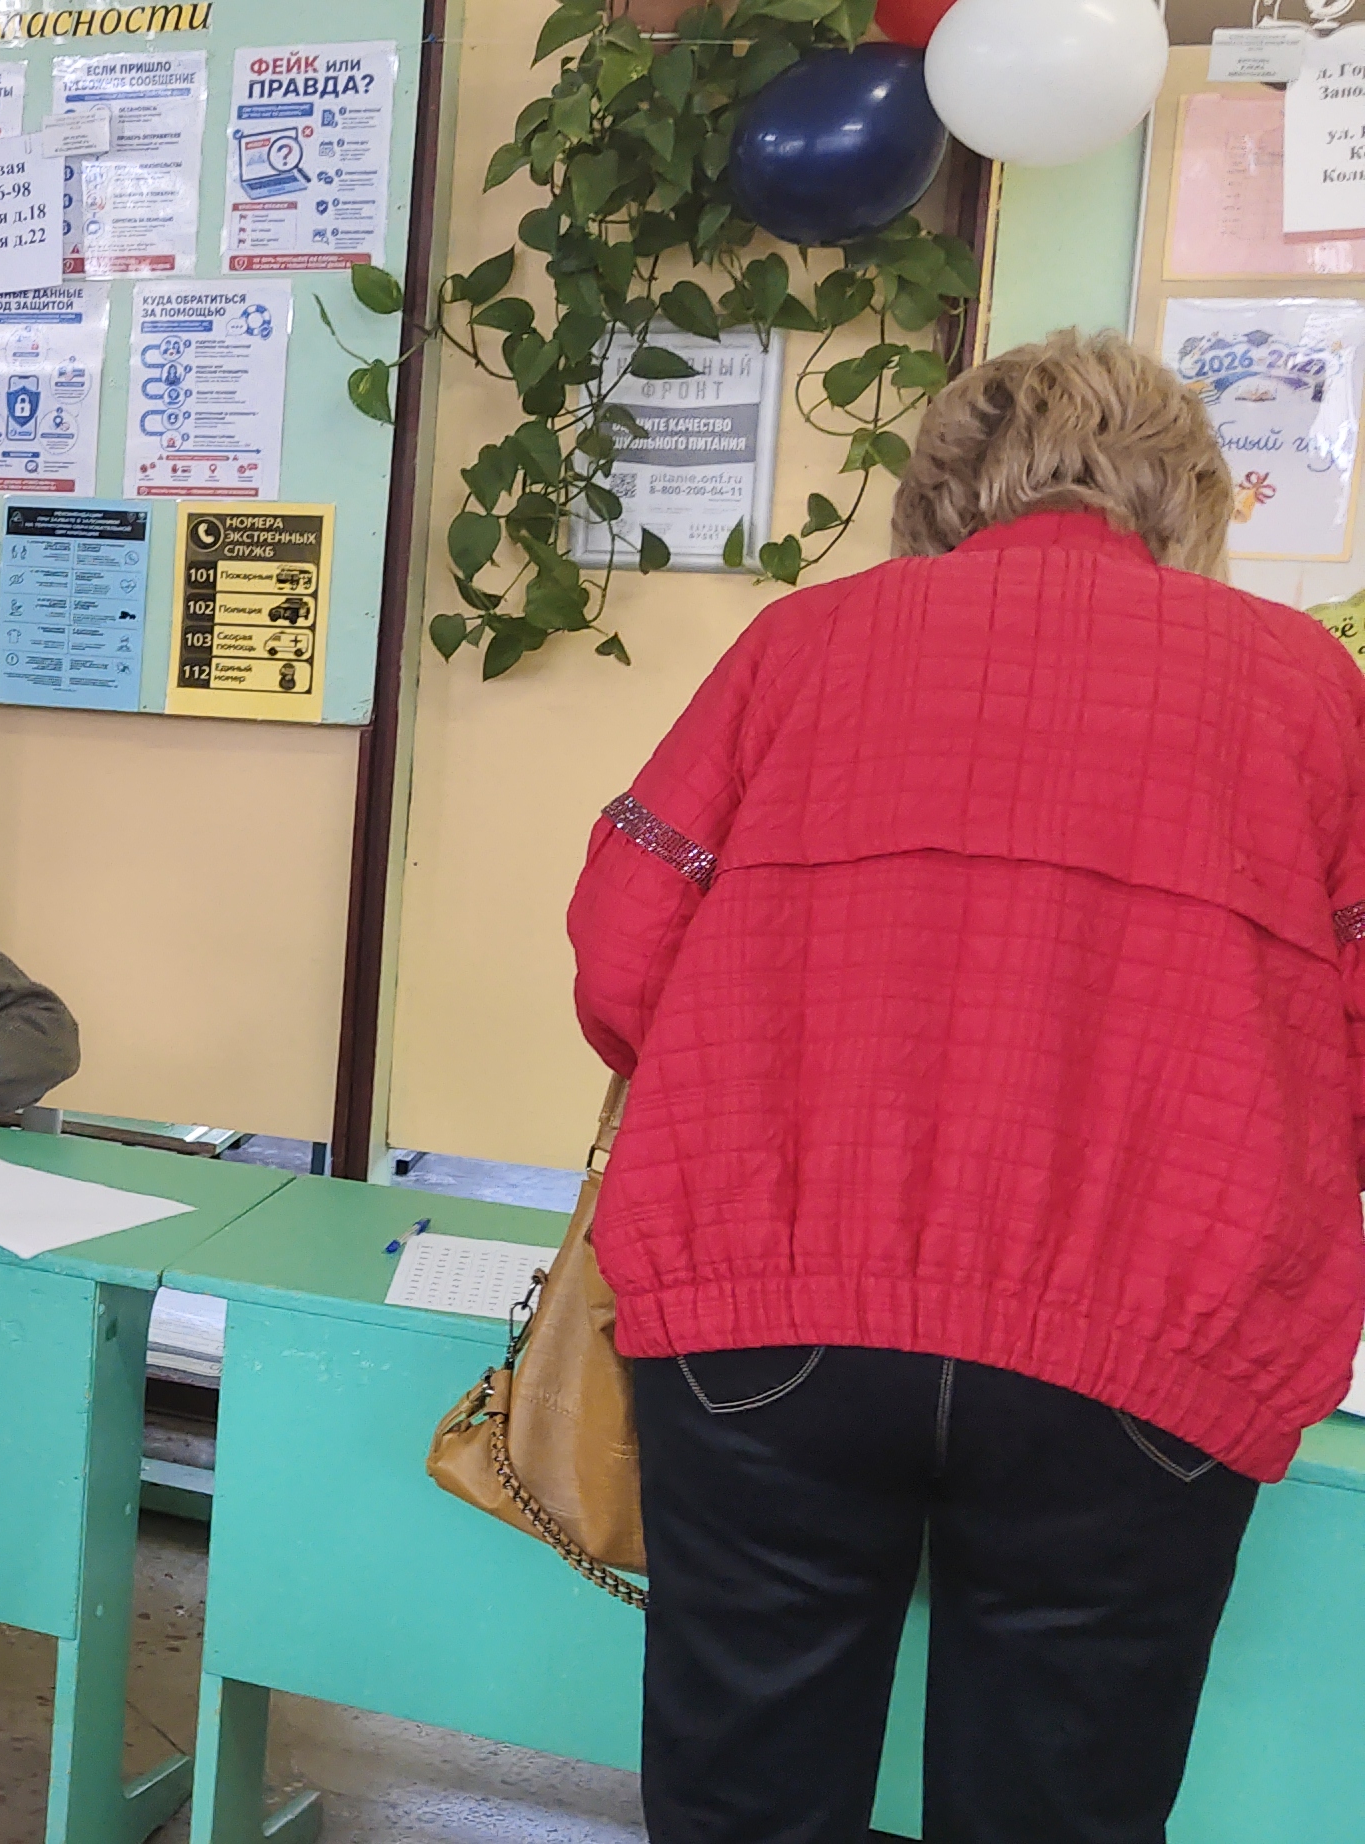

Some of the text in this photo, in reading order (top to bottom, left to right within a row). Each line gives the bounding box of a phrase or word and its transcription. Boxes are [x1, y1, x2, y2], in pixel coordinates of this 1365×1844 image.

[87, 61, 172, 77] ЕСЛИ ПРИШЛО
[250, 51, 361, 76] ФЕЙК ИЛИ
[129, 71, 197, 87] СООБЩЕНИЕ
[248, 74, 375, 99] ПРАВДА?
[1319, 85, 1365, 101] Запо
[12, 203, 47, 223] д.18
[13, 228, 47, 249] д.22
[32, 287, 84, 300] ДАННЫЕ
[142, 294, 248, 306] КУДА ОБРАТИТЬСЯ
[14, 299, 74, 312] ЗАЩИТОЙ
[141, 306, 227, 318] ЗА ПОМОЩЬЮ
[641, 381, 723, 400] ФРОНТ
[669, 417, 732, 433] КАЧЕСТВО
[688, 437, 746, 451] ПИТАНИЯ
[226, 516, 284, 529] НОМЕРА
[224, 531, 317, 544] ЭКСТРЕННЫХ
[223, 545, 275, 557] СЛУЖБ
[189, 568, 274, 583] 101 Пожарные
[187, 600, 263, 616] 102 Полиция
[185, 631, 253, 647] 103 Скорая
[216, 643, 257, 653] помощь
[182, 662, 253, 680] 112 Единый
[214, 674, 247, 684] номер
